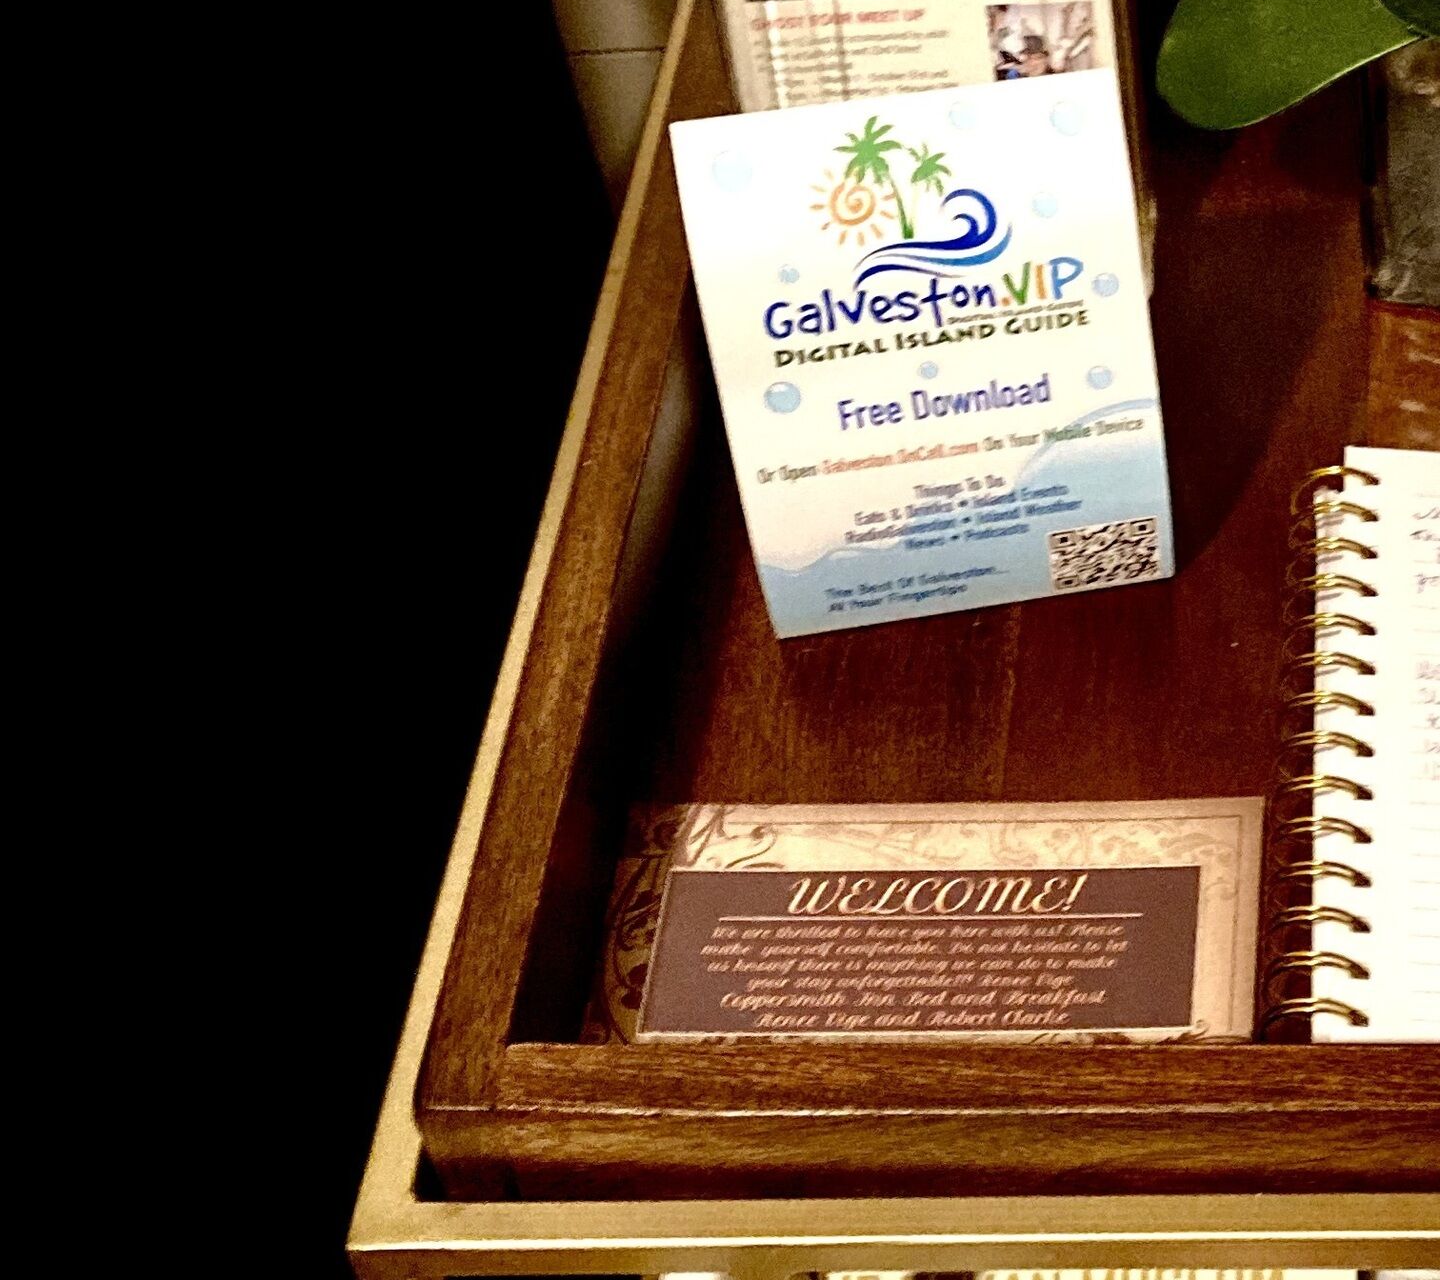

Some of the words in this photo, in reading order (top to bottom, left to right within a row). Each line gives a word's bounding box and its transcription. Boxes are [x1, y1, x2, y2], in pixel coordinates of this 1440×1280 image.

[773, 337, 888, 369] DIGITAL
[895, 323, 997, 352] ISLAND
[1005, 310, 1091, 336] GUIDE
[838, 399, 904, 431] Free
[910, 372, 1051, 421] Download
[787, 874, 1088, 915] WELCOME!
[720, 992, 847, 1011] Coppersmith
[852, 992, 897, 1007] Inn
[901, 991, 948, 1007] Bed
[949, 990, 999, 1007] and
[1001, 989, 1107, 1011] Breakfast
[873, 1011, 922, 1027] and
[926, 1010, 997, 1028] Robert
